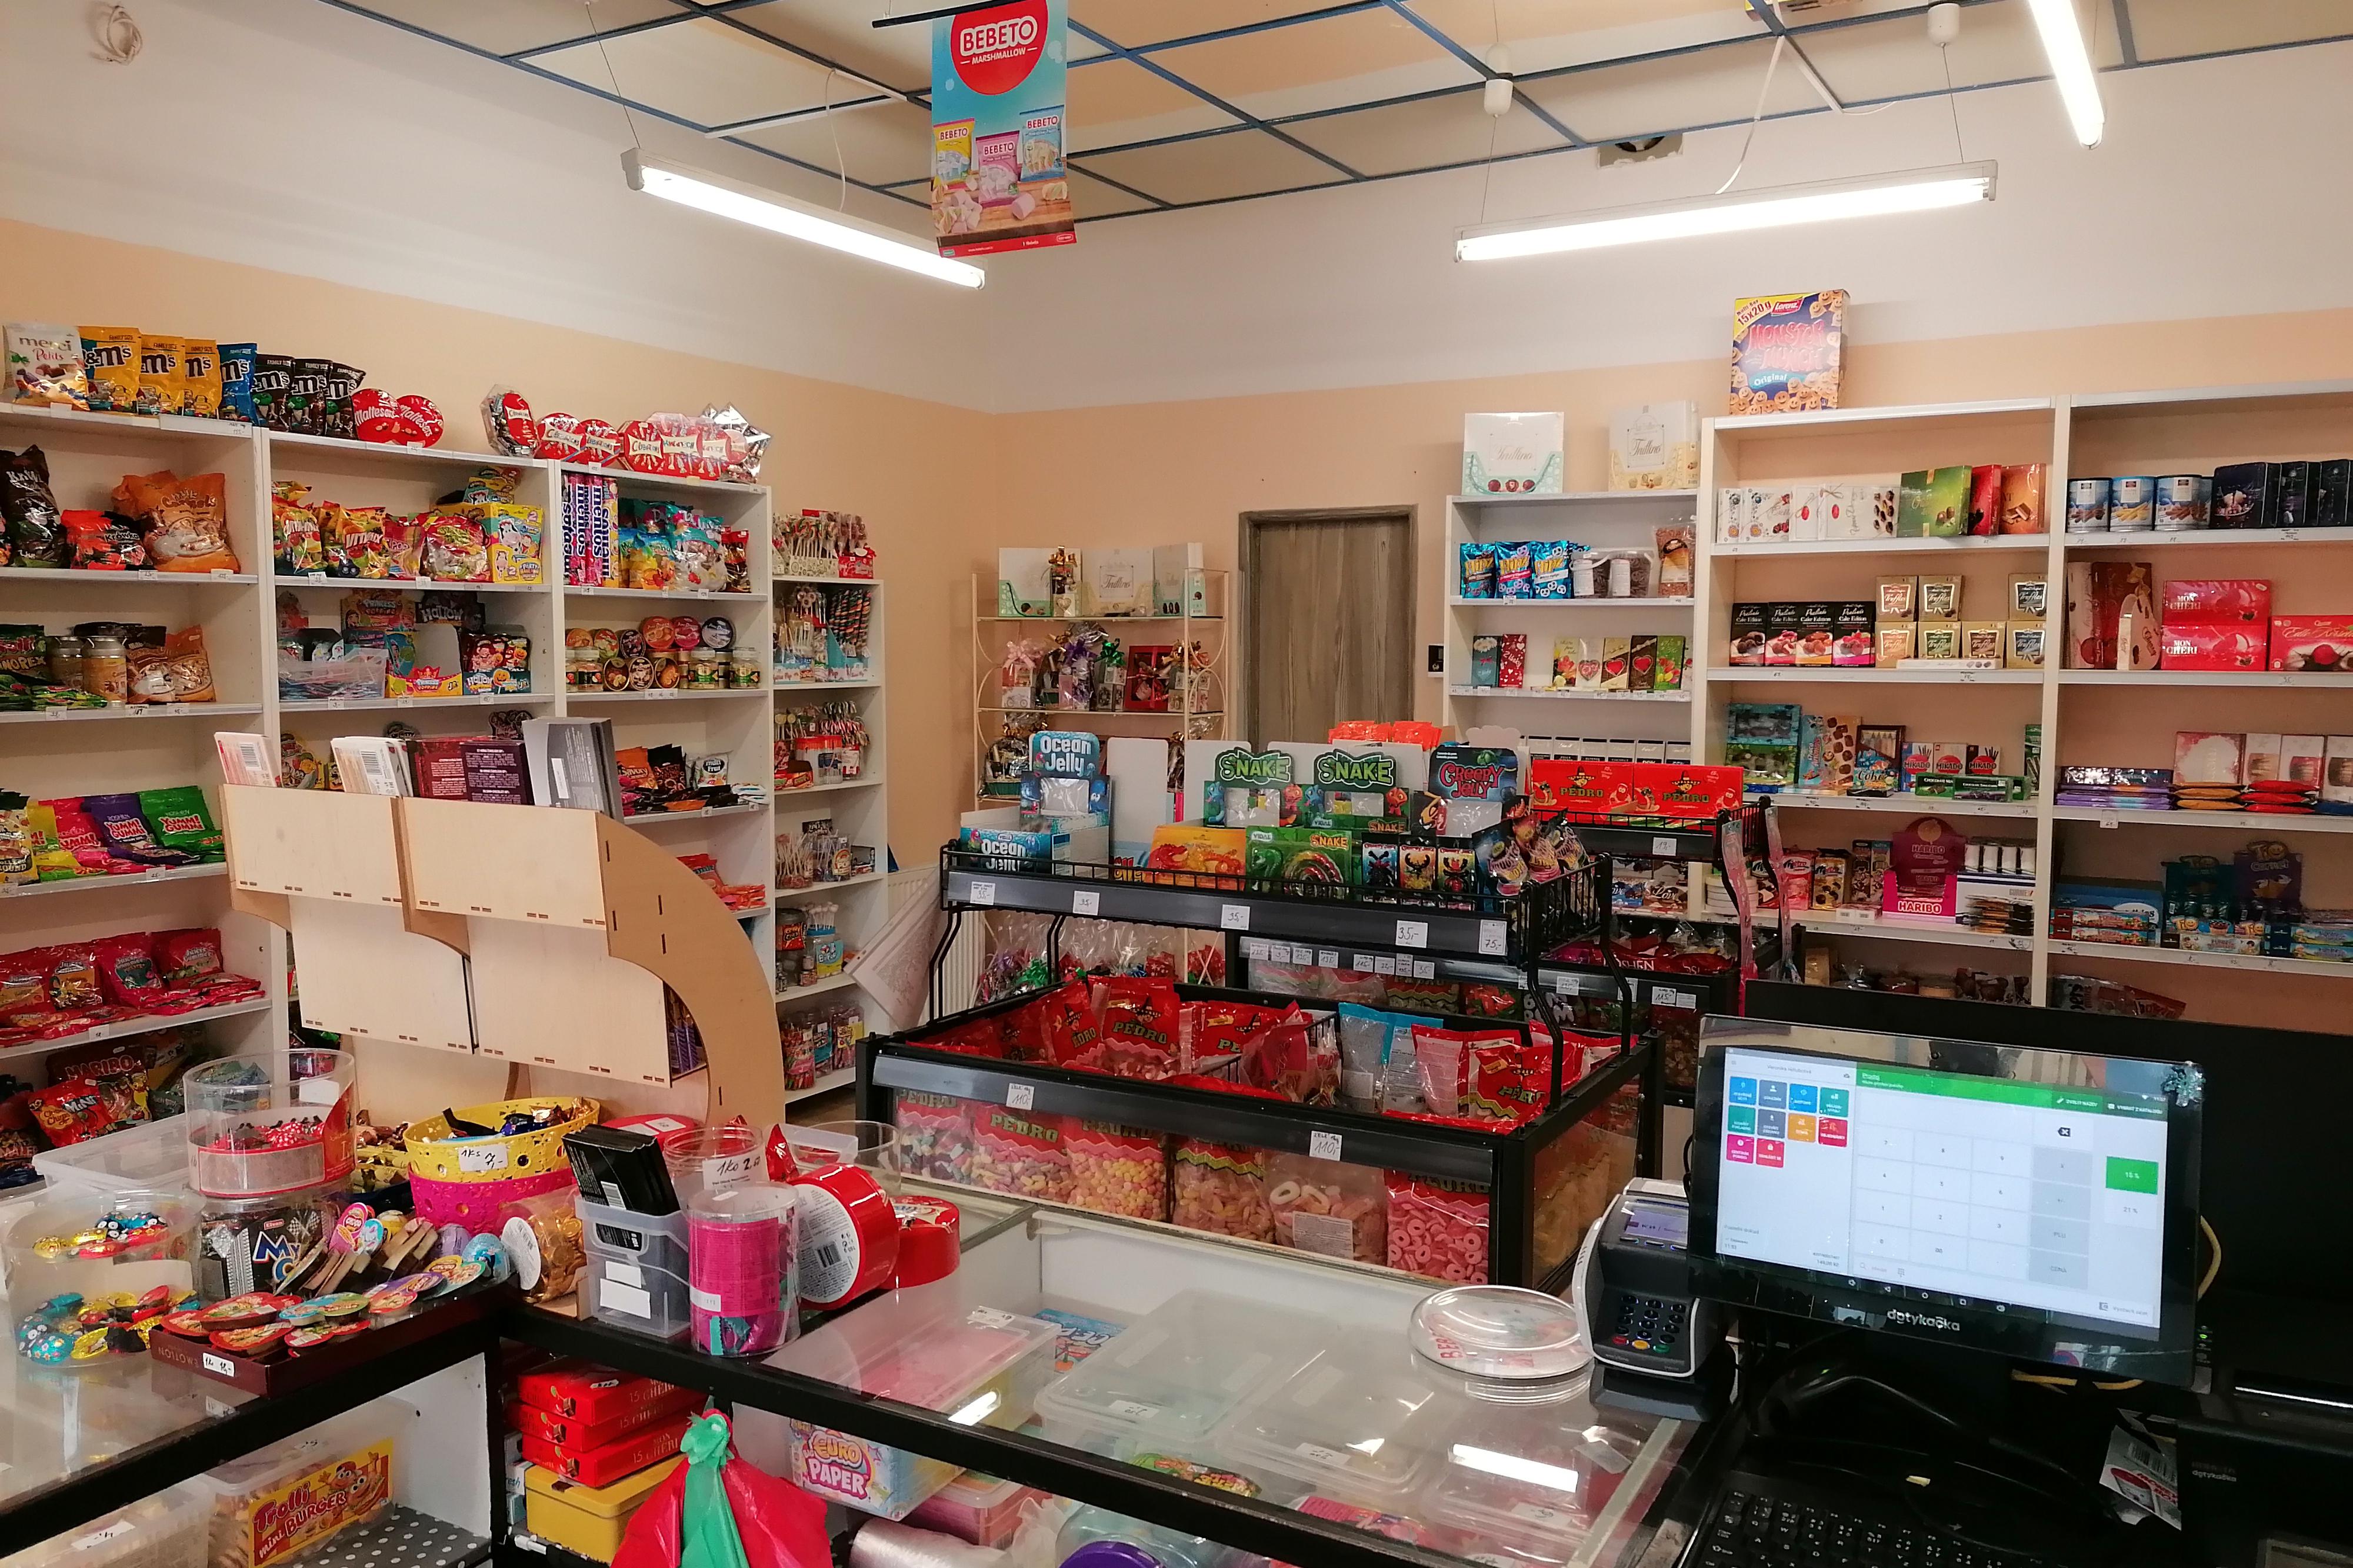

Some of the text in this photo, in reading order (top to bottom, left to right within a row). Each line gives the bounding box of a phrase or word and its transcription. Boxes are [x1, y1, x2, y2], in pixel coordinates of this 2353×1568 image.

[961, 17, 1038, 55] BEBETO
[971, 47, 1026, 64] MARSHMALLOW
[1026, 116, 1058, 129] BEBETO
[939, 128, 968, 141] BEBETO
[984, 142, 1015, 155] BEBETO
[1775, 301, 1799, 311] Lorenz
[19, 336, 72, 352] merci
[32, 348, 64, 362] Petits
[1754, 373, 1788, 386] Original
[401, 404, 432, 438] Maltesers
[576, 485, 586, 557] mentos
[592, 485, 602, 558] mentos
[602, 508, 611, 578] mentos
[2166, 646, 2198, 655] CHERI
[1039, 735, 1092, 755] Ocean
[1046, 753, 1085, 776] Jelly
[1219, 756, 1291, 782] SNAKE
[1318, 755, 1394, 786] SNAKE
[1904, 761, 1931, 770] MIKADO
[1935, 762, 1964, 771] MIKADO
[1969, 760, 1998, 770] MIKADO
[1559, 786, 1604, 798] PEDRO
[1662, 792, 1709, 803] PEDRO
[981, 838, 1026, 858] Ocean
[1311, 834, 1349, 849] SNAKE
[1898, 900, 1942, 915] HARIBO
[1112, 1021, 1168, 1045] PEDRO
[990, 1114, 1059, 1143] PEDRO
[1887, 1307, 1961, 1333] dotykačka
[808, 1459, 868, 1496] PAPER
[252, 1481, 311, 1532] Trolli
[285, 1491, 346, 1537] BURGER
[258, 1529, 285, 1558] mini
